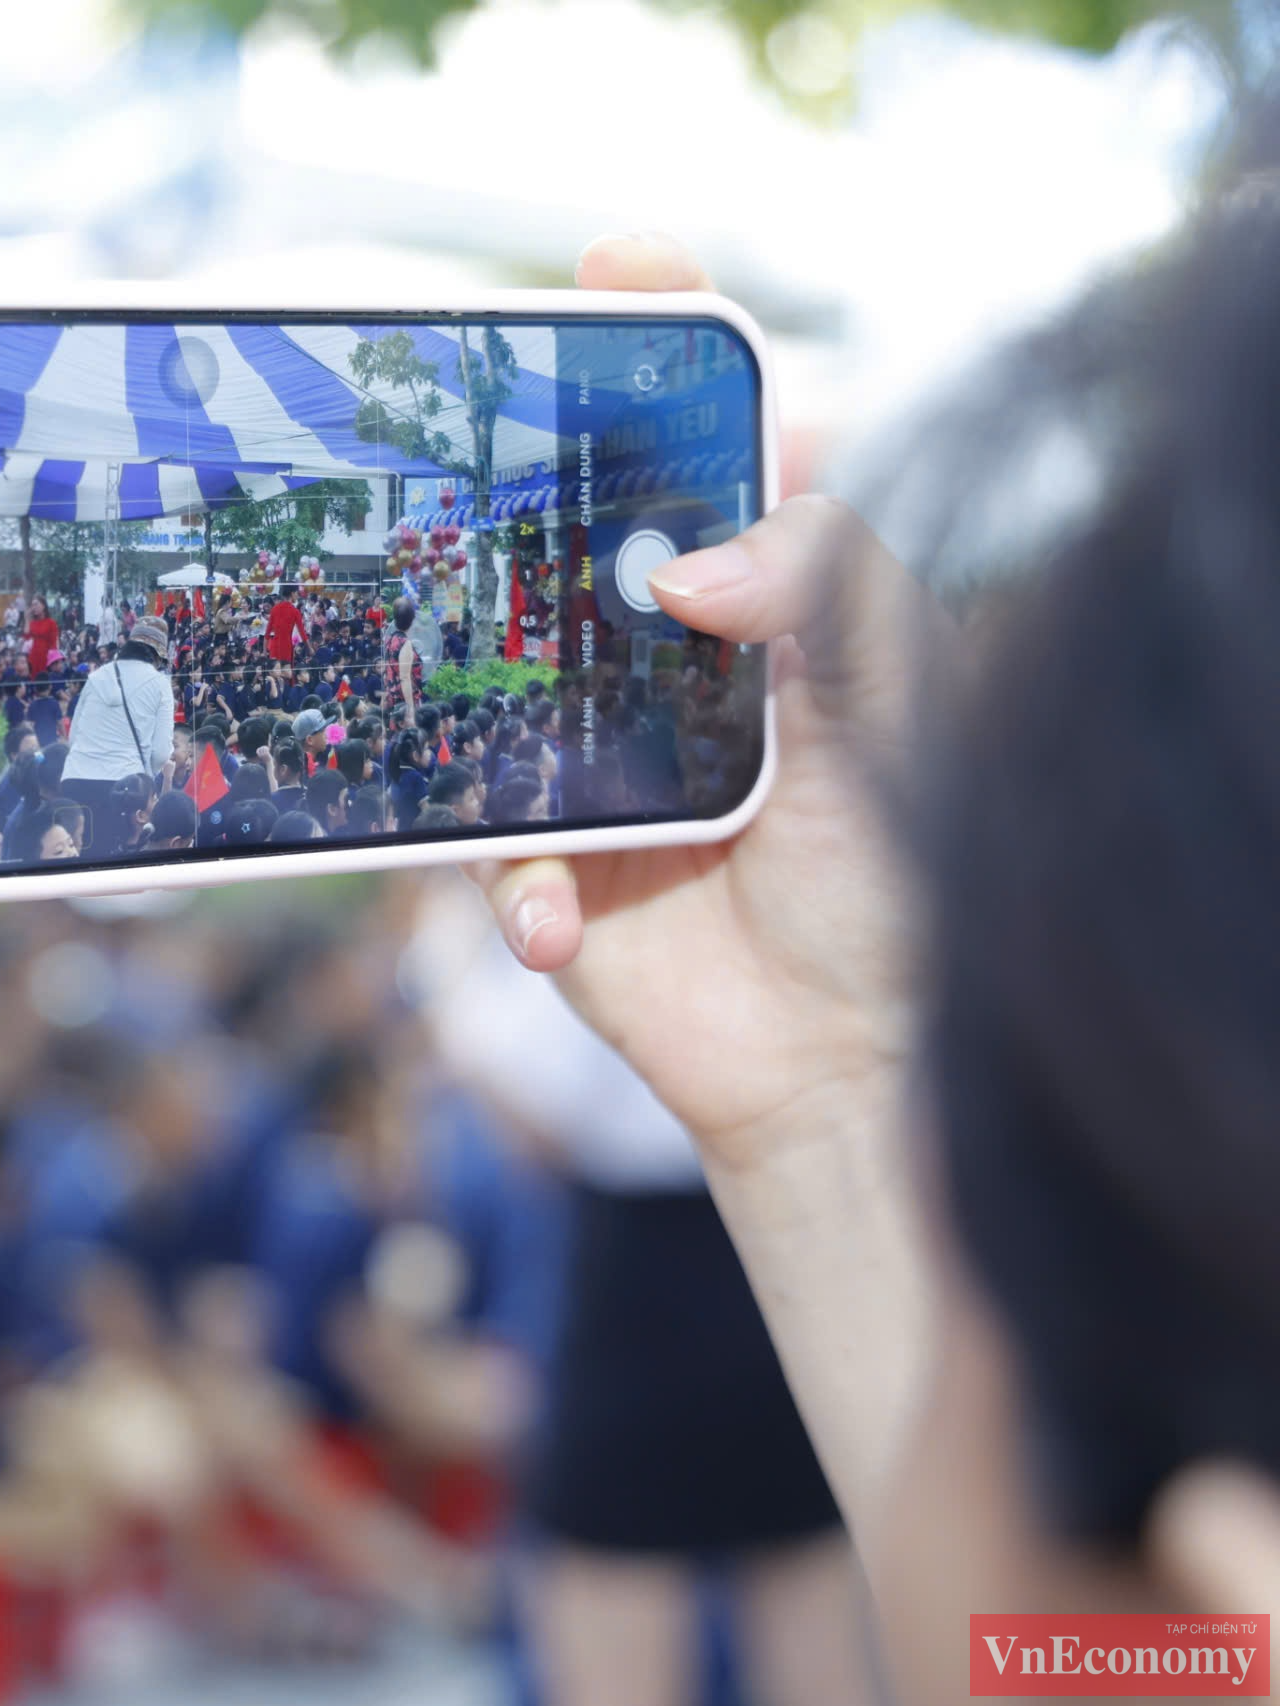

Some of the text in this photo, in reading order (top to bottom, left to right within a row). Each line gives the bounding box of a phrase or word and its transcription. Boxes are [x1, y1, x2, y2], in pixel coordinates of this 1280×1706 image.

[578, 432, 593, 527] CHÂN DUNG
[520, 523, 535, 535] 2x
[581, 620, 593, 668] VIDEO
